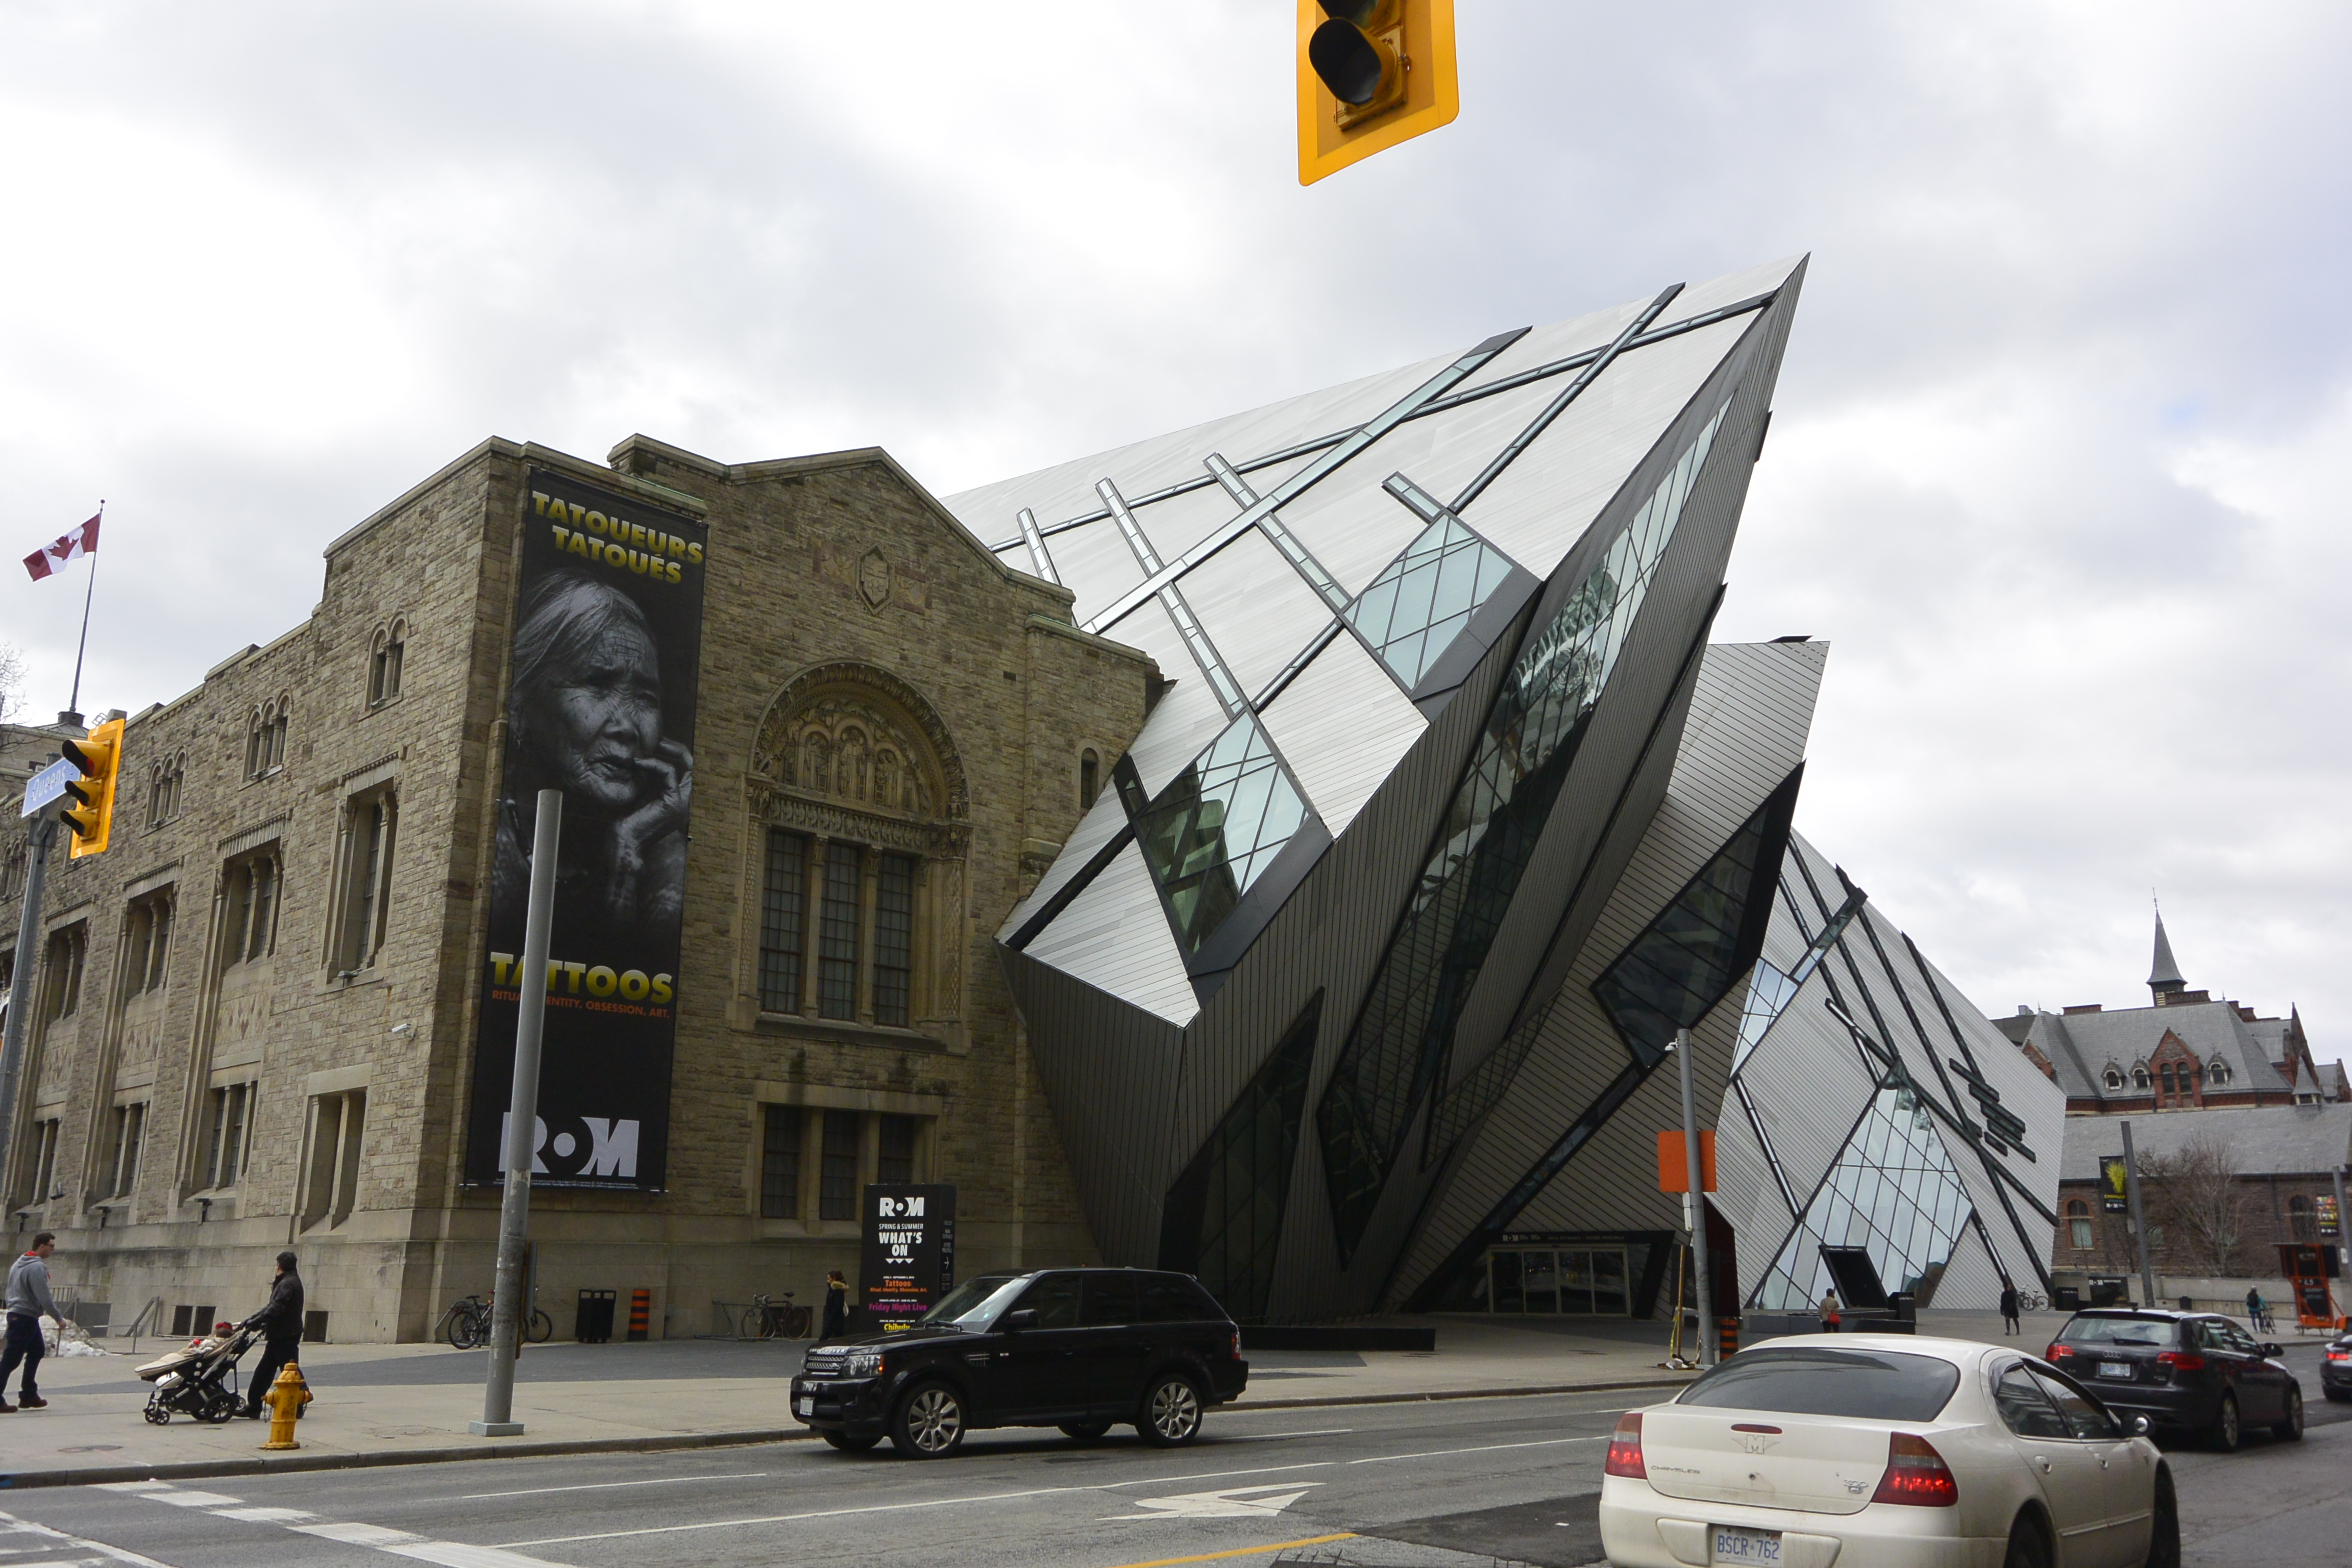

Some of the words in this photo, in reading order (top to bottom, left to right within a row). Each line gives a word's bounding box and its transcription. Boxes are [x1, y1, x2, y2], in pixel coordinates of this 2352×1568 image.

[532, 491, 702, 564] TATOUEURS
[552, 525, 681, 584] TATOUÉS
[33, 766, 66, 801] Queens
[585, 1001, 646, 1016] OBSESSION.
[649, 1008, 670, 1019] ART.
[879, 1197, 924, 1216] ROM
[879, 1232, 922, 1244] WHAT'S
[892, 1244, 908, 1256] ON
[869, 1303, 890, 1313] Friday
[892, 1303, 911, 1313] Night
[1651, 1465, 1700, 1474] CHRYSLER
[1718, 1535, 1748, 1556] BSCR
[1756, 1540, 1779, 1559] 762
